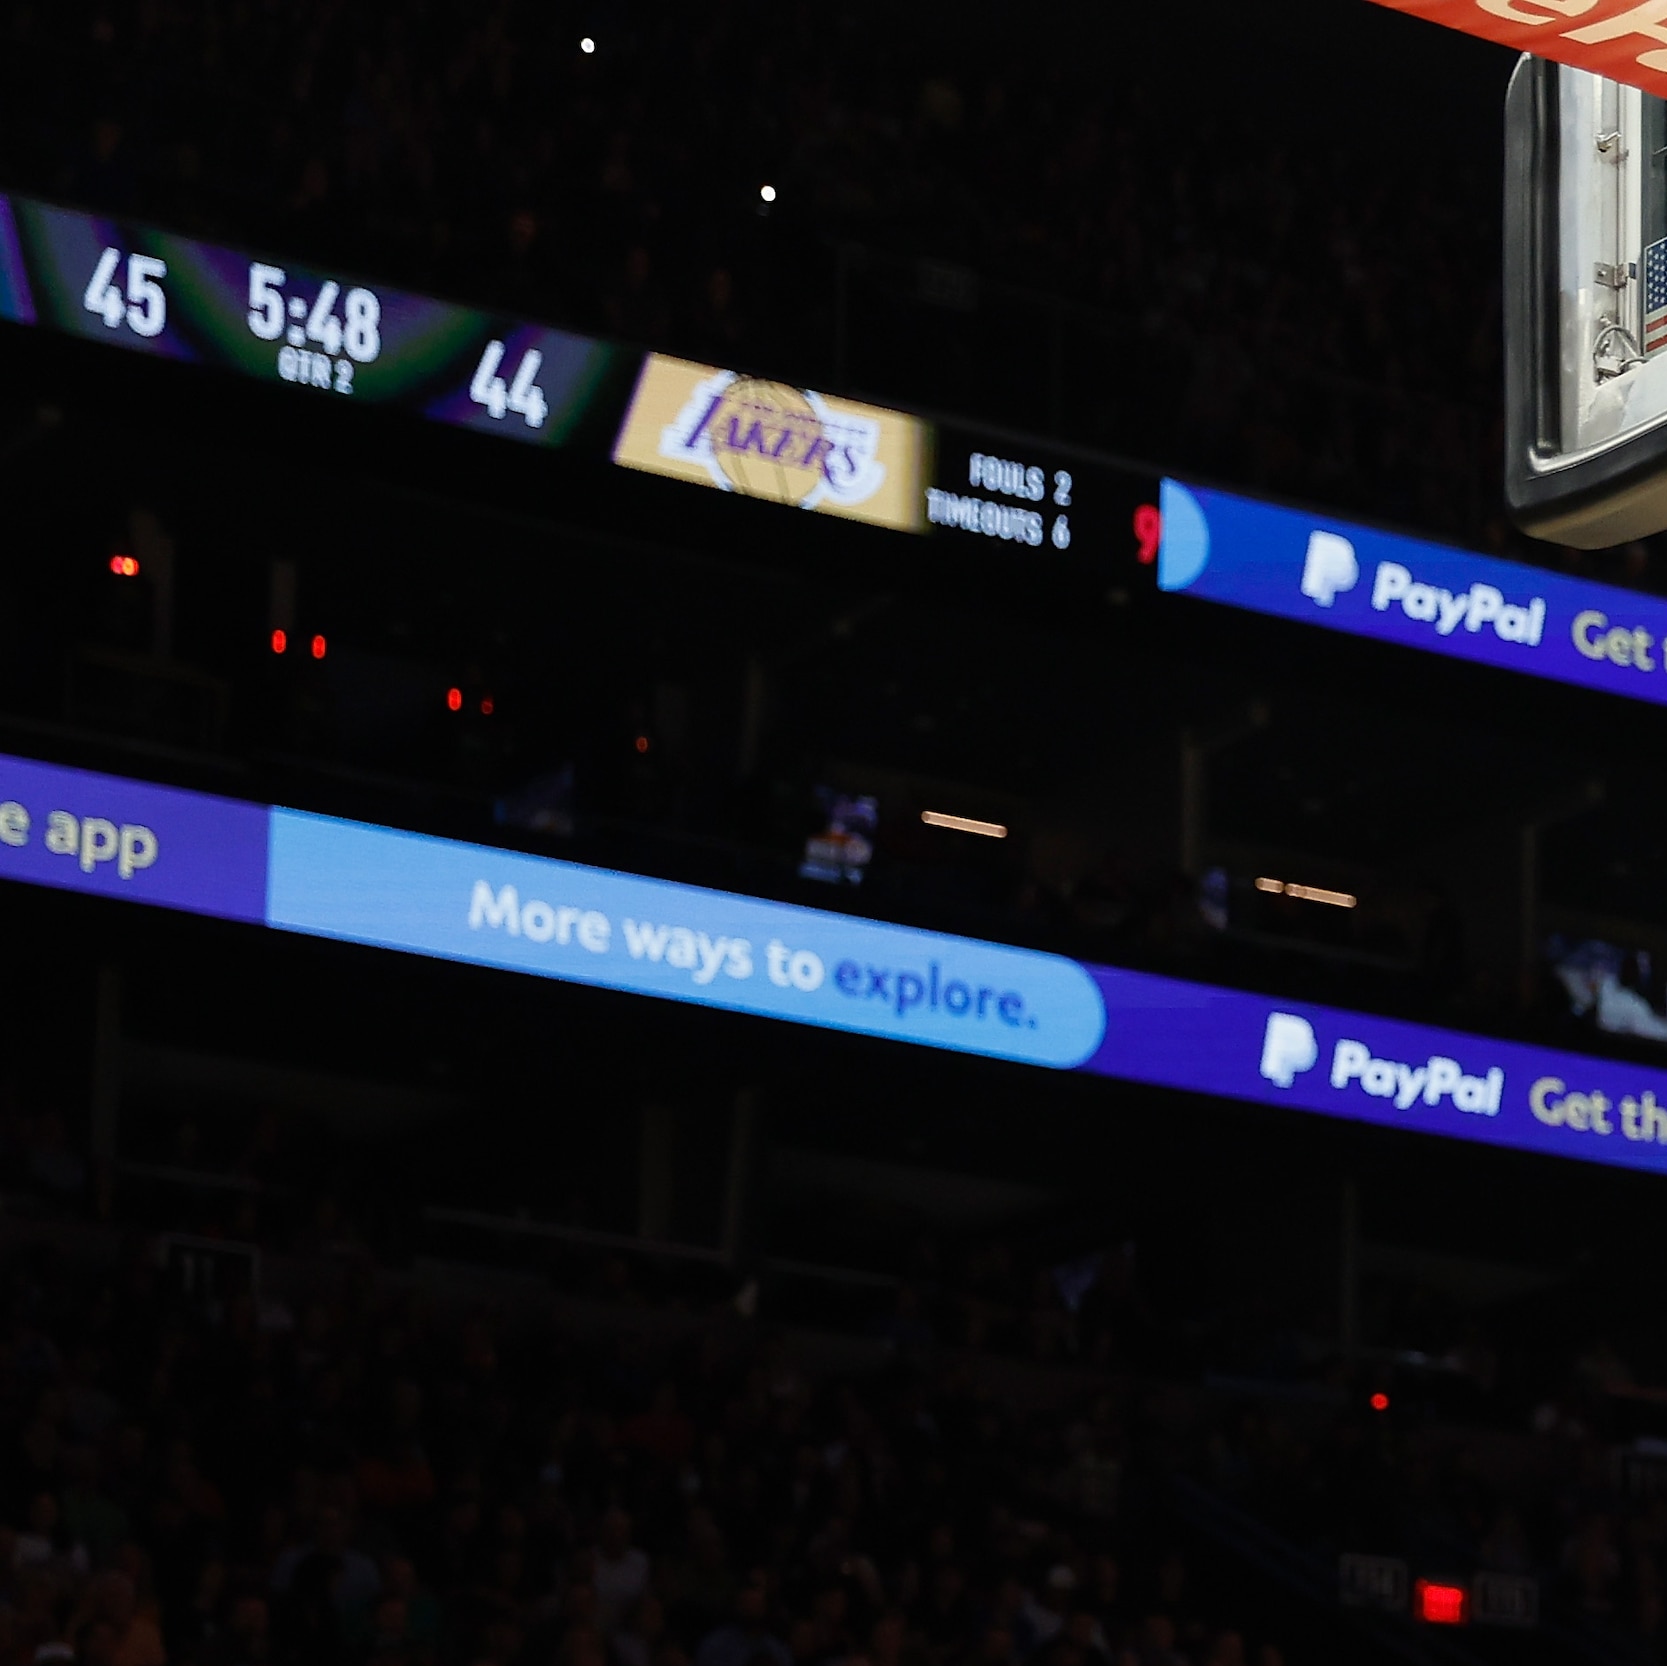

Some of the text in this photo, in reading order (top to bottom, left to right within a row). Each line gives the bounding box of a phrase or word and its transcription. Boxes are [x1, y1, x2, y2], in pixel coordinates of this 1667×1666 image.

[83, 246, 167, 337] 45
[247, 262, 381, 363] 5:48
[277, 345, 355, 394] QTR 2
[469, 339, 549, 429] 44
[926, 487, 1071, 549] TIMEOUTS 6
[969, 452, 1072, 506] FOULS 2
[1372, 560, 1547, 647] PayPal
[1570, 608, 1655, 673] Get
[45, 807, 159, 880] app
[467, 878, 1041, 1032] More ways to explore.
[1330, 1038, 1504, 1117] PayPal
[1529, 1075, 1613, 1136] Get
